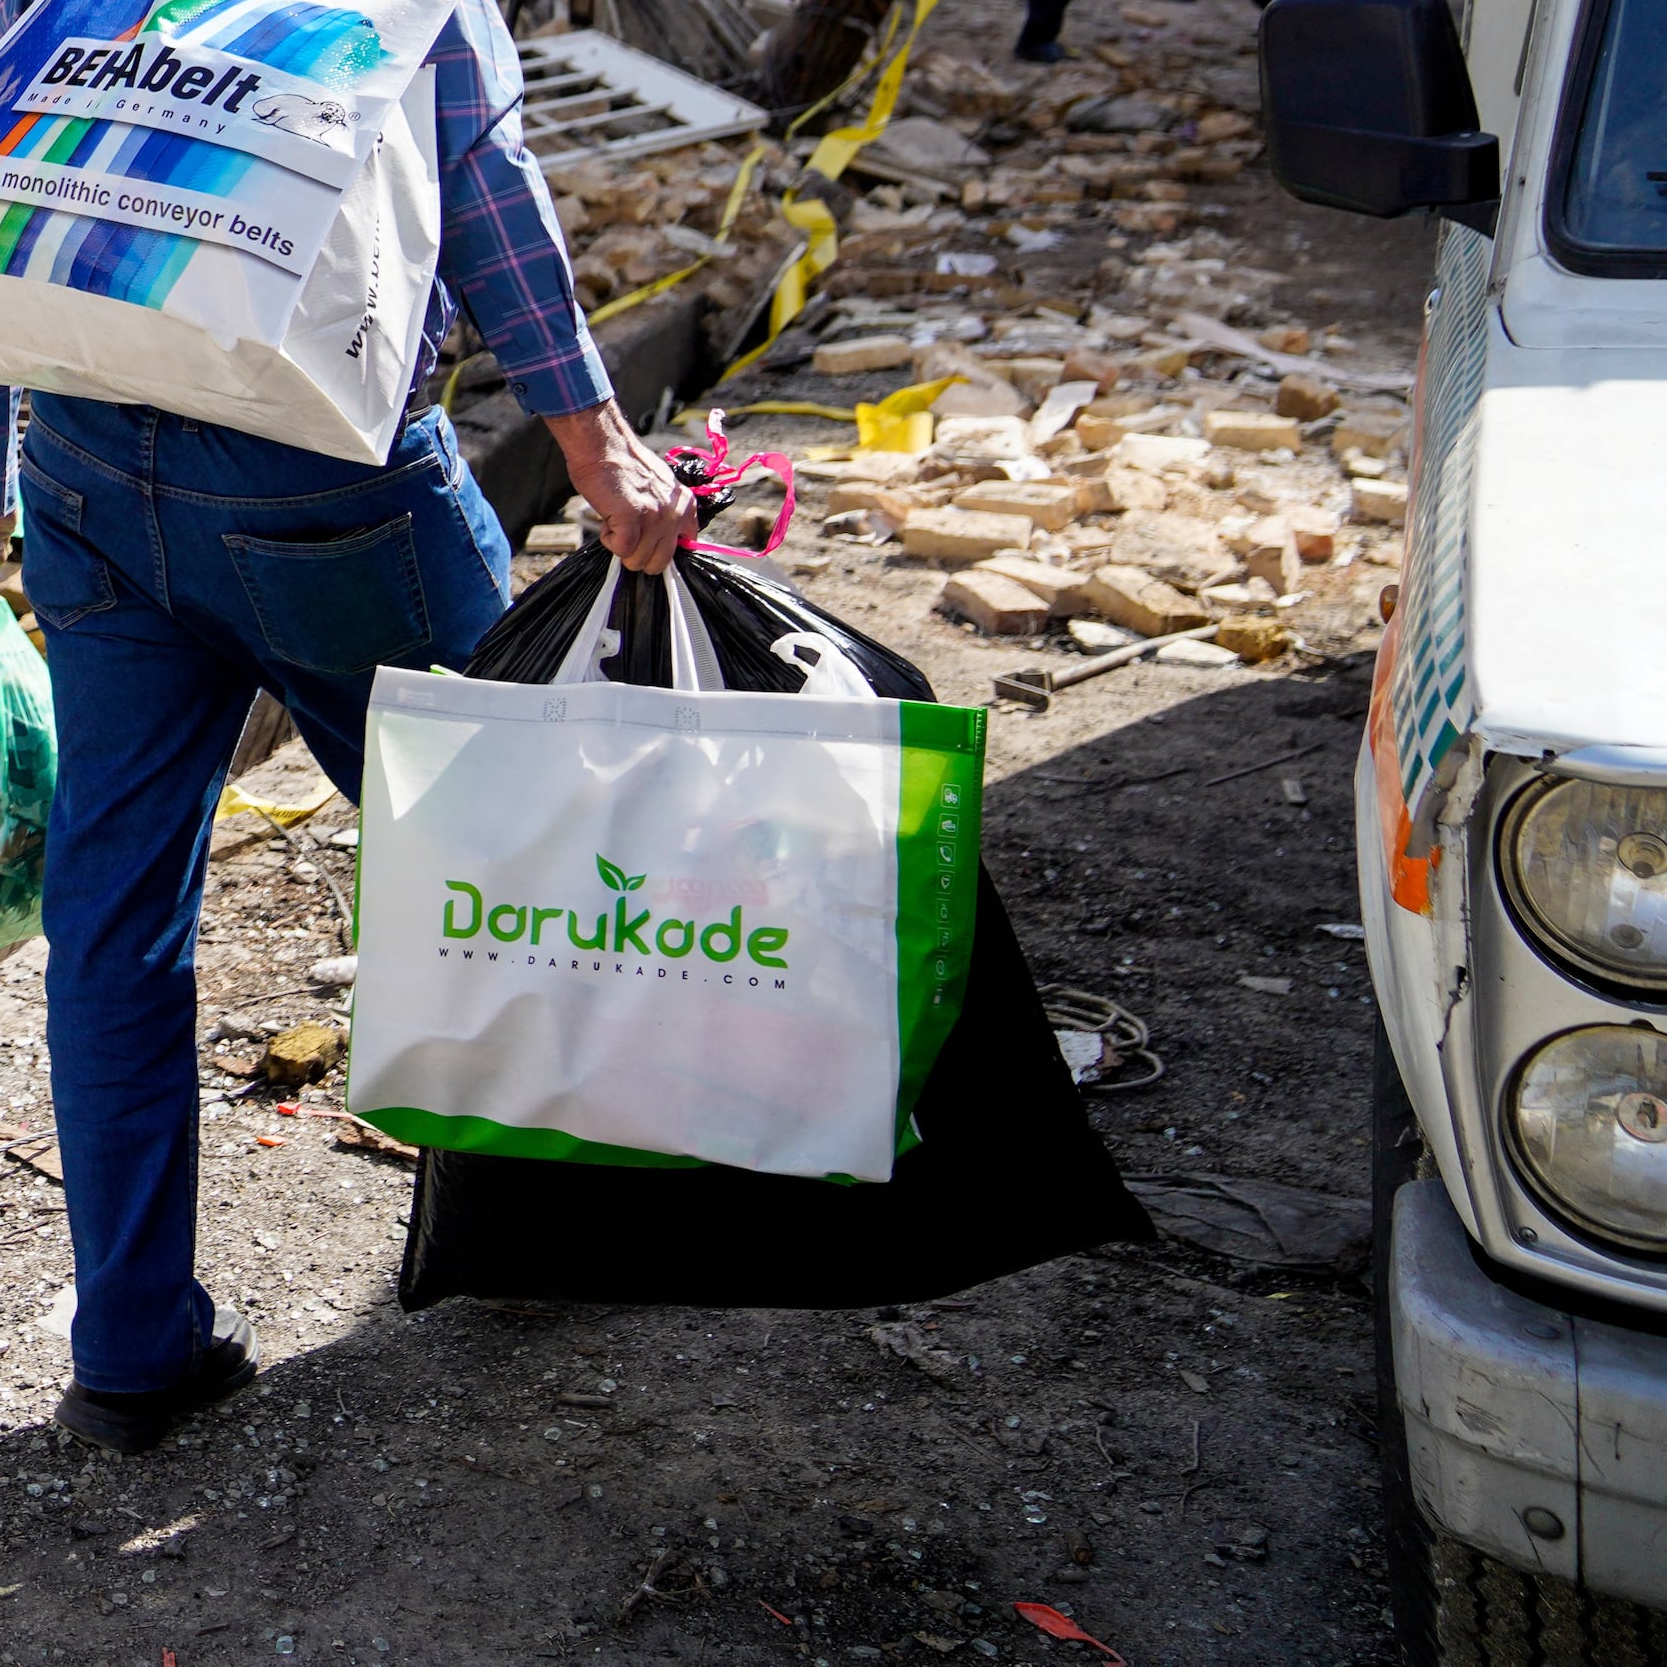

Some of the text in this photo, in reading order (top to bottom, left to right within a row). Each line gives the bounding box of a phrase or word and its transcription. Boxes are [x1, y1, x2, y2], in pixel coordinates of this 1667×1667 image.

[27, 92, 71, 105] Made
[116, 99, 228, 135] Germany
[41, 43, 263, 115] BEHAbelt
[3, 172, 111, 207] monolithic
[117, 193, 225, 230] conveyor
[228, 214, 295, 257] belts
[442, 879, 789, 969] Darukade
[438, 946, 786, 990] WWW.DARUKADE.COM
